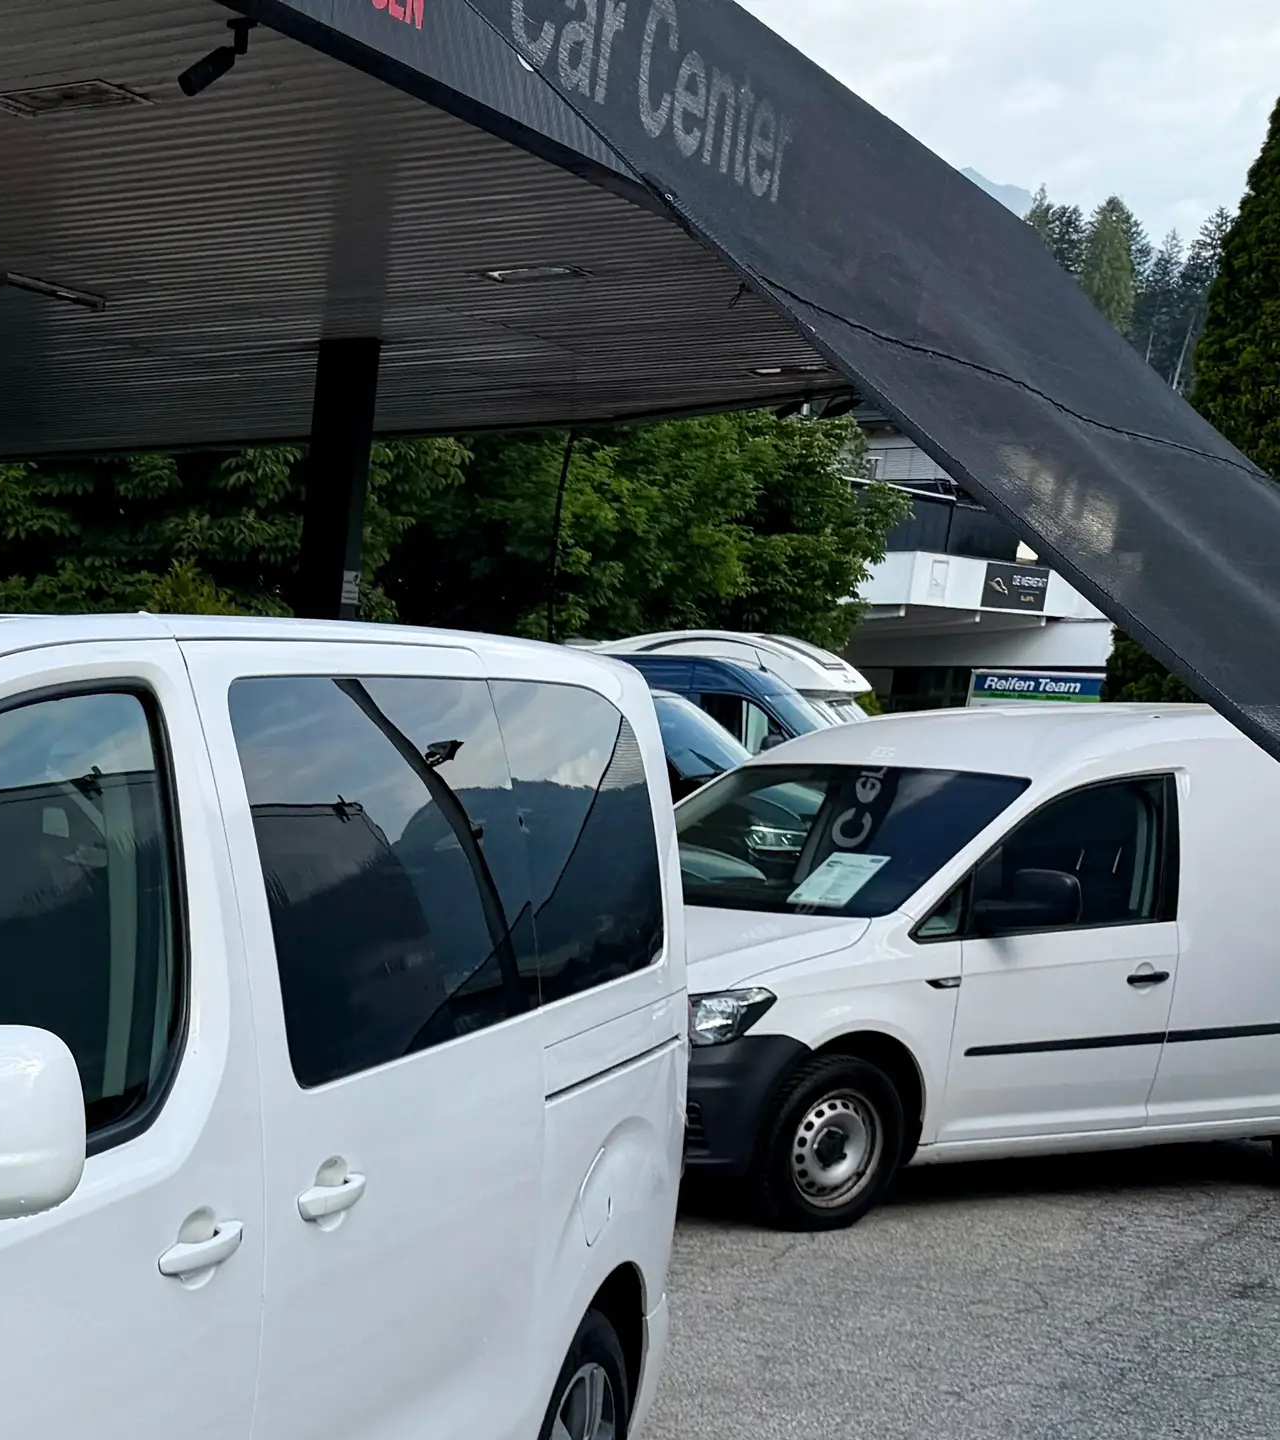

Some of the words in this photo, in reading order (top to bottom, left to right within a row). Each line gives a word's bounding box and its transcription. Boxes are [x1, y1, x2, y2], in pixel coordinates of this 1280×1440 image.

[638, 0, 793, 202] Center
[984, 676, 1035, 691] Reifen
[1038, 678, 1082, 693] Team
